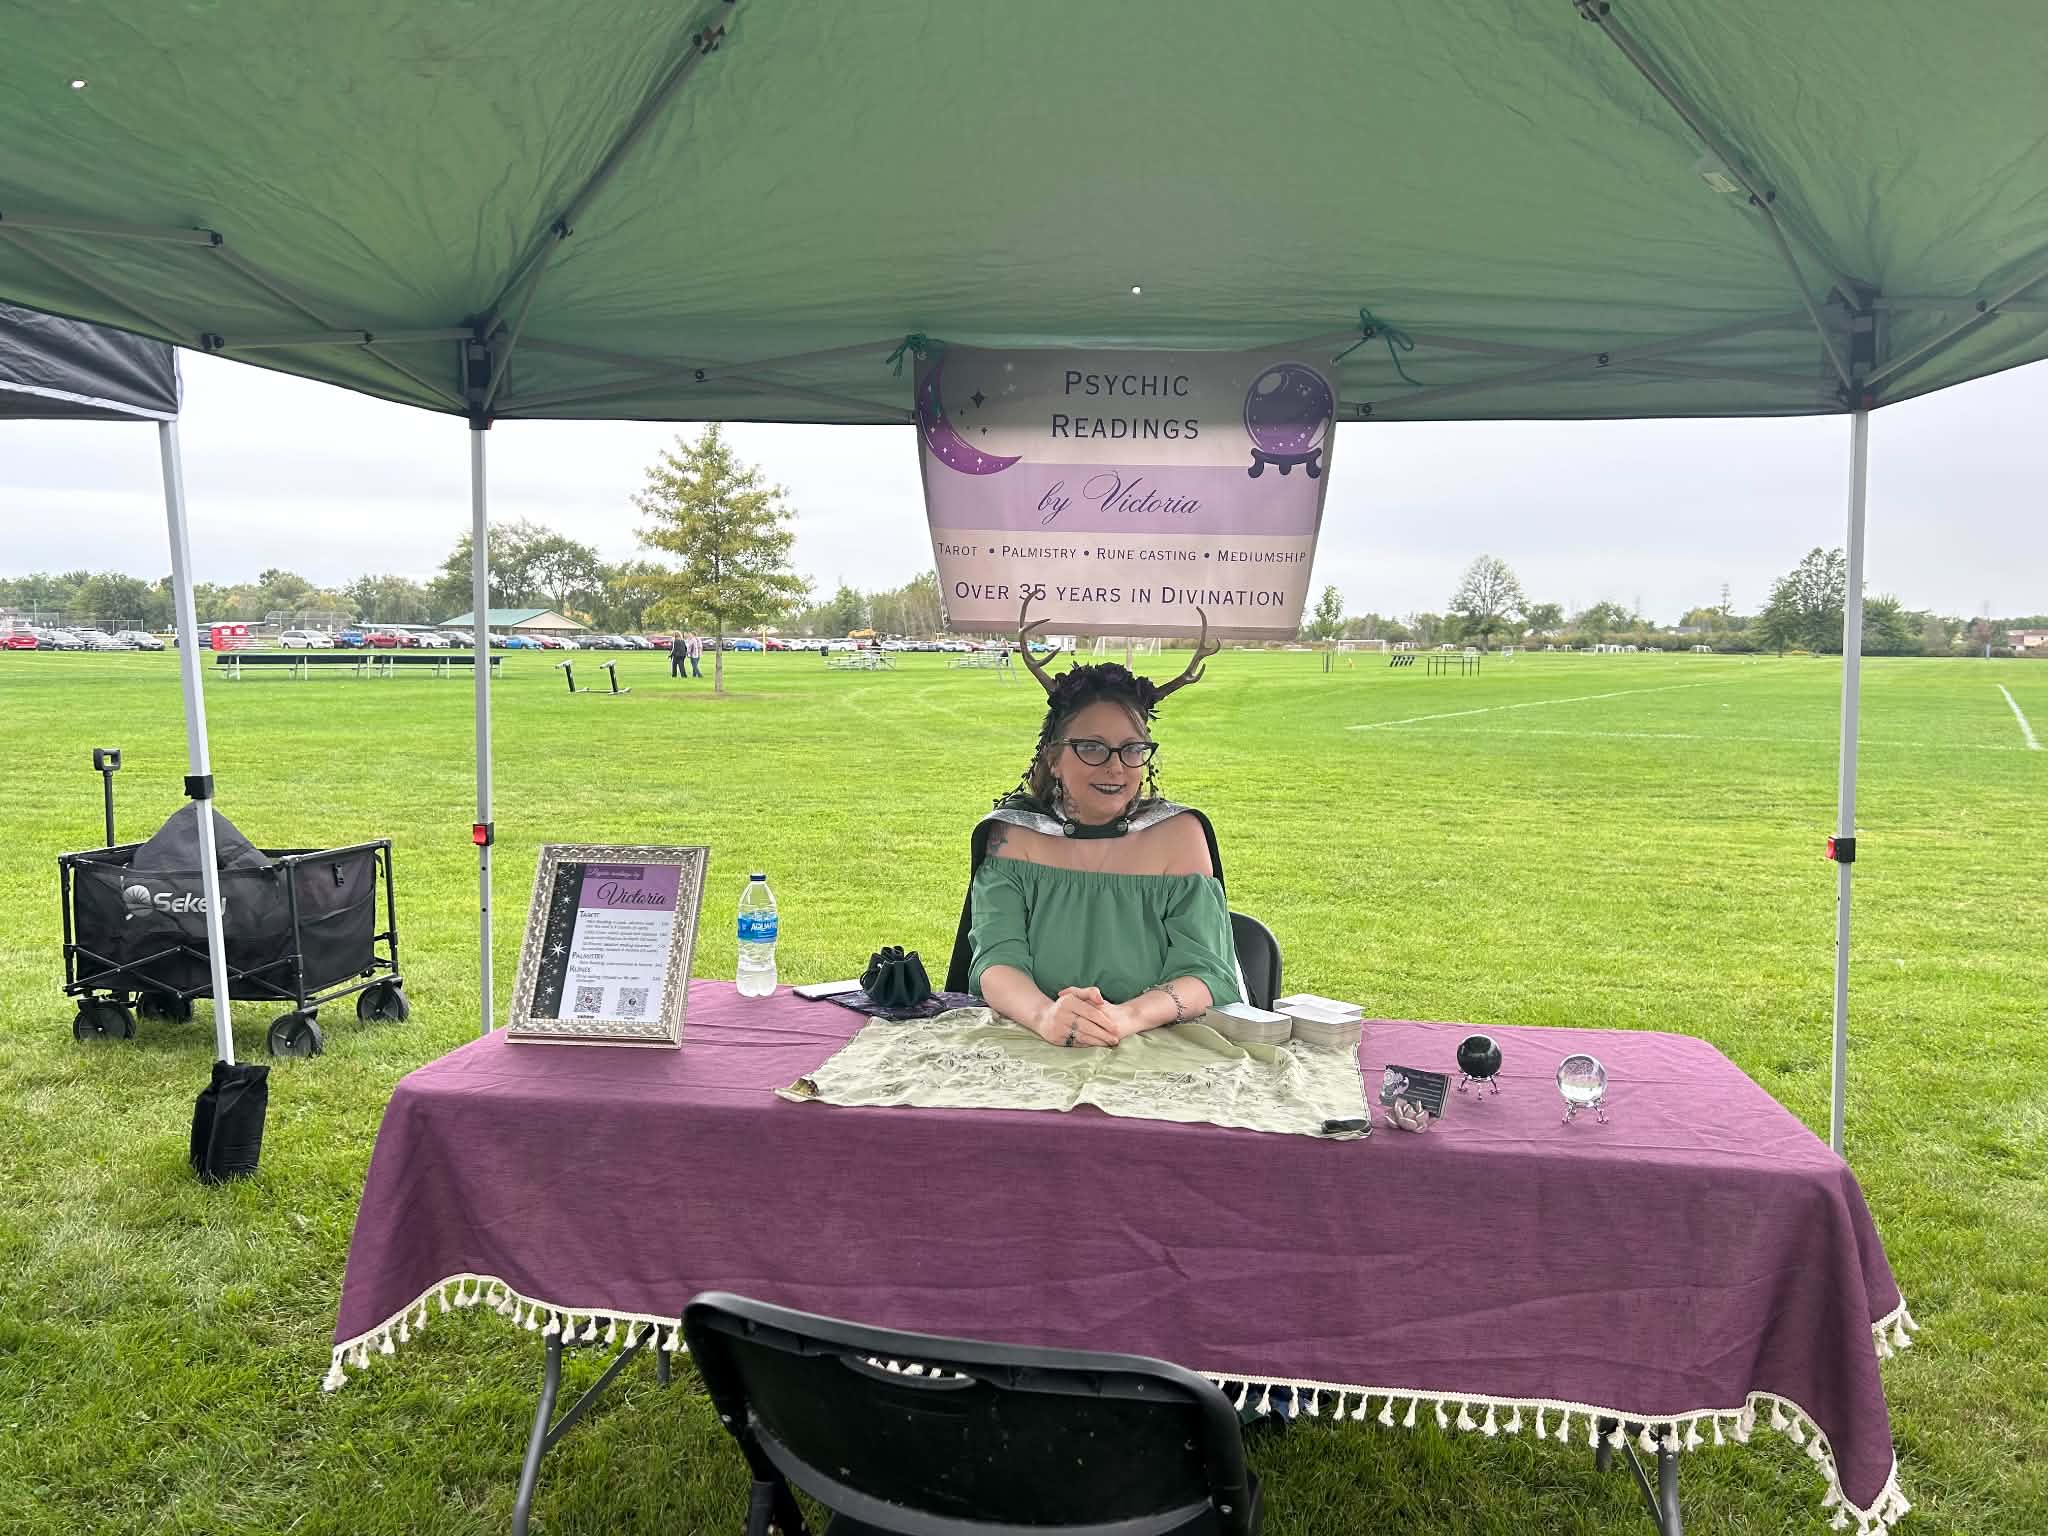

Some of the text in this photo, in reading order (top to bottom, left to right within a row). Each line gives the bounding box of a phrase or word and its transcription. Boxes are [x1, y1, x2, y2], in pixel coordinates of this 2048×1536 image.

[1064, 371, 1190, 397] PSYCHIC
[1051, 414, 1199, 440] READINGS
[1037, 470, 1201, 525] by Victoria
[937, 542, 1307, 562] TAROT PALMISTRY RUNE CASTING MEDIUMSHIP
[955, 581, 1285, 607] OVER 35 YEARS IN DIVINATION
[597, 881, 667, 906] Victoria
